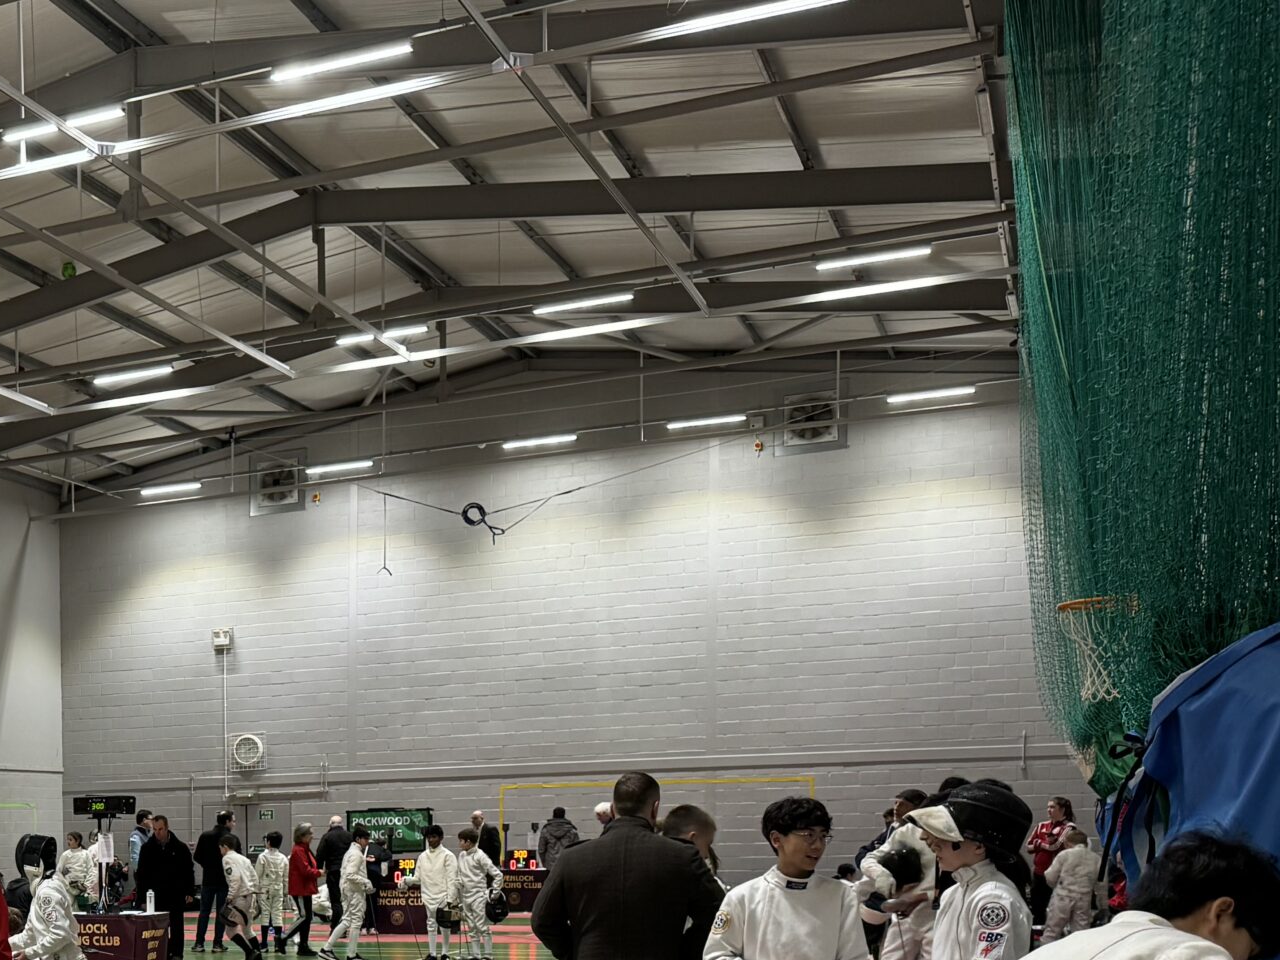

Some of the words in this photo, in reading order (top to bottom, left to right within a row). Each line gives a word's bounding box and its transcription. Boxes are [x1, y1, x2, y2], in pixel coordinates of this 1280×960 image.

[352, 816, 410, 827] PACKWOOD
[399, 859, 415, 869] 3:00
[510, 859, 516, 870] 0
[530, 859, 536, 870] 0
[394, 871, 402, 883] 0
[408, 898, 423, 906] CLU
[79, 923, 108, 934] LOCK
[92, 936, 121, 946] CLUB
